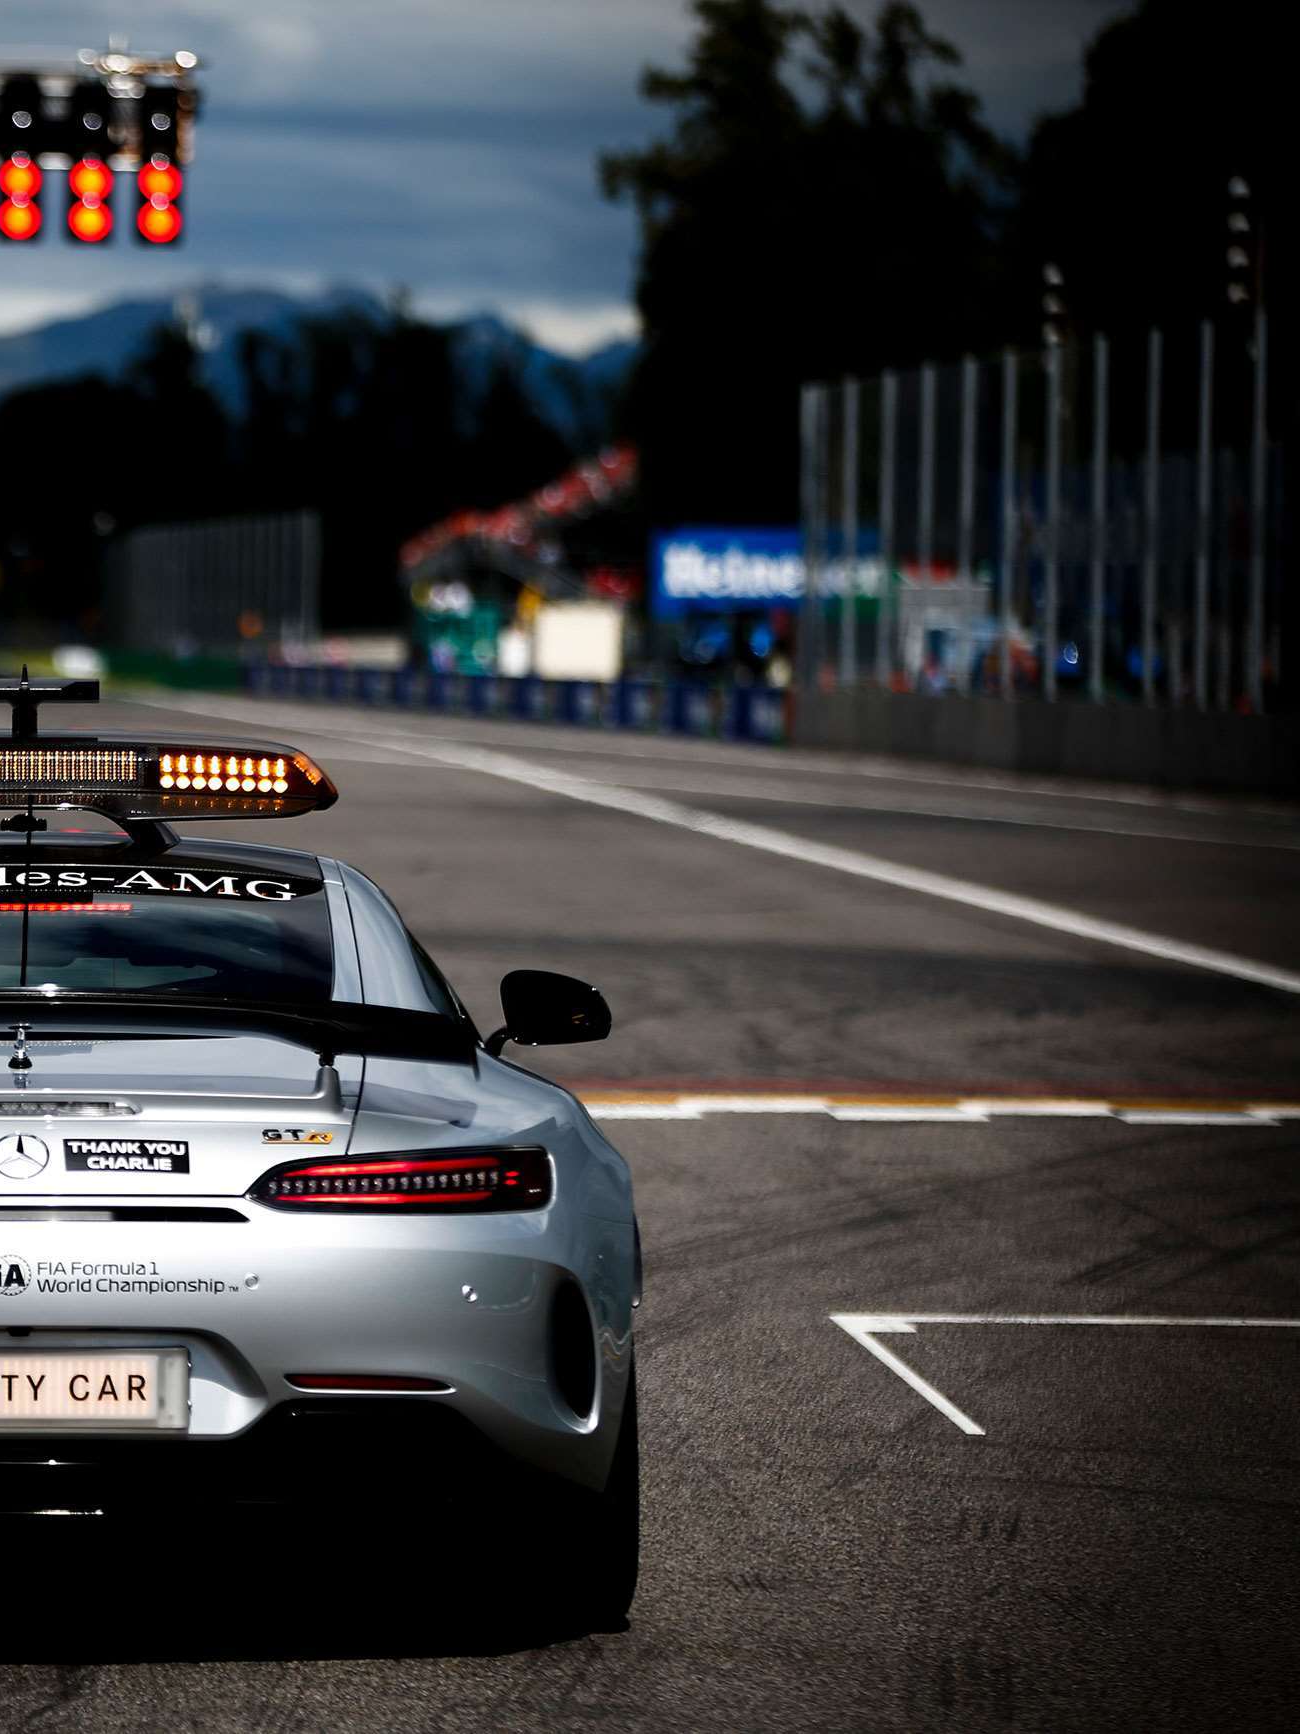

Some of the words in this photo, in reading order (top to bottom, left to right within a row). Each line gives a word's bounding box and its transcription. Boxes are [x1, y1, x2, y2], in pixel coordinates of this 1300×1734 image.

[67, 1140, 141, 1156] THANK
[146, 1141, 186, 1156] YOU
[87, 1155, 172, 1171] CHARLIE
[37, 1261, 66, 1275] FIA
[71, 1261, 147, 1275] Formula
[150, 1261, 159, 1276] 1
[37, 1278, 92, 1292] World
[68, 1374, 147, 1401] CAR
